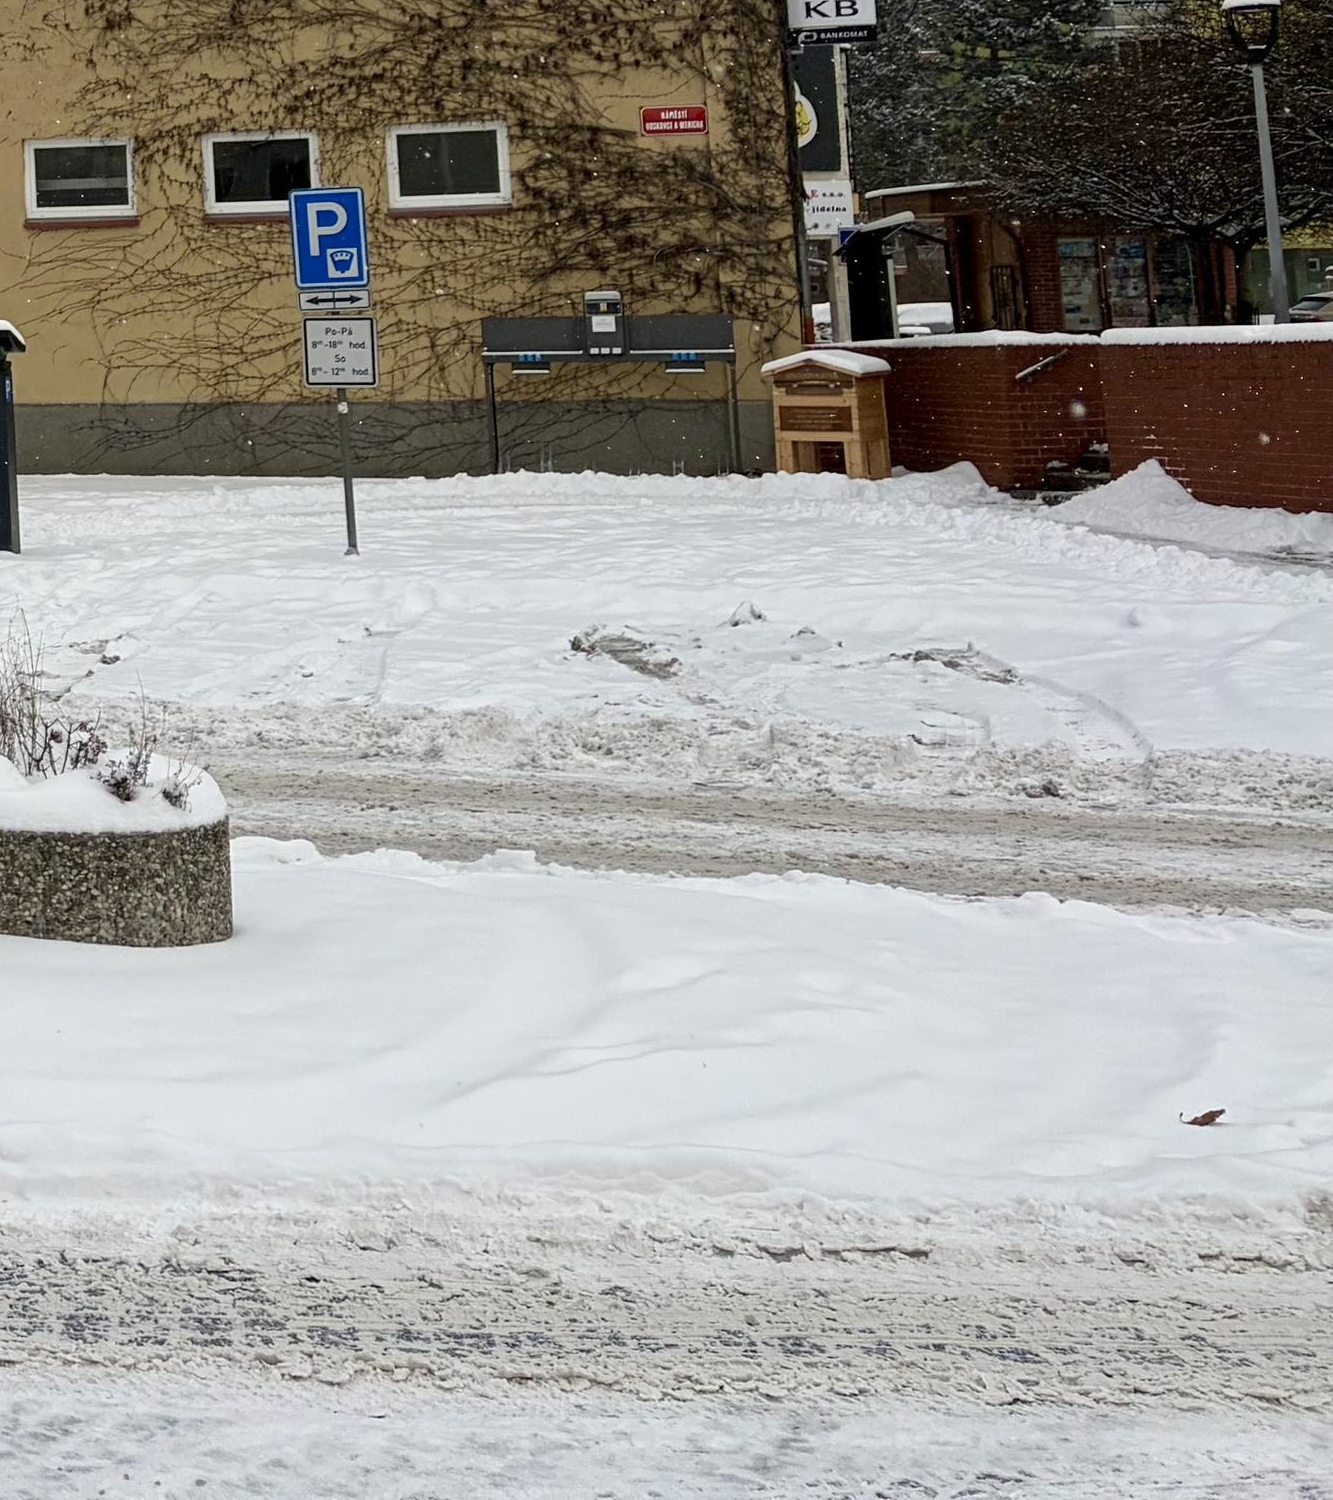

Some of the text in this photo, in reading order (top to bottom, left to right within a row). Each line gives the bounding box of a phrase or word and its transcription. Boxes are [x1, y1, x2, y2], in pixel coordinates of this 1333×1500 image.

[805, 0, 859, 19] KB
[820, 30, 868, 39] BANKOMAT
[307, 201, 348, 257] P
[325, 326, 353, 336] Po-Pá
[334, 354, 346, 363] So
